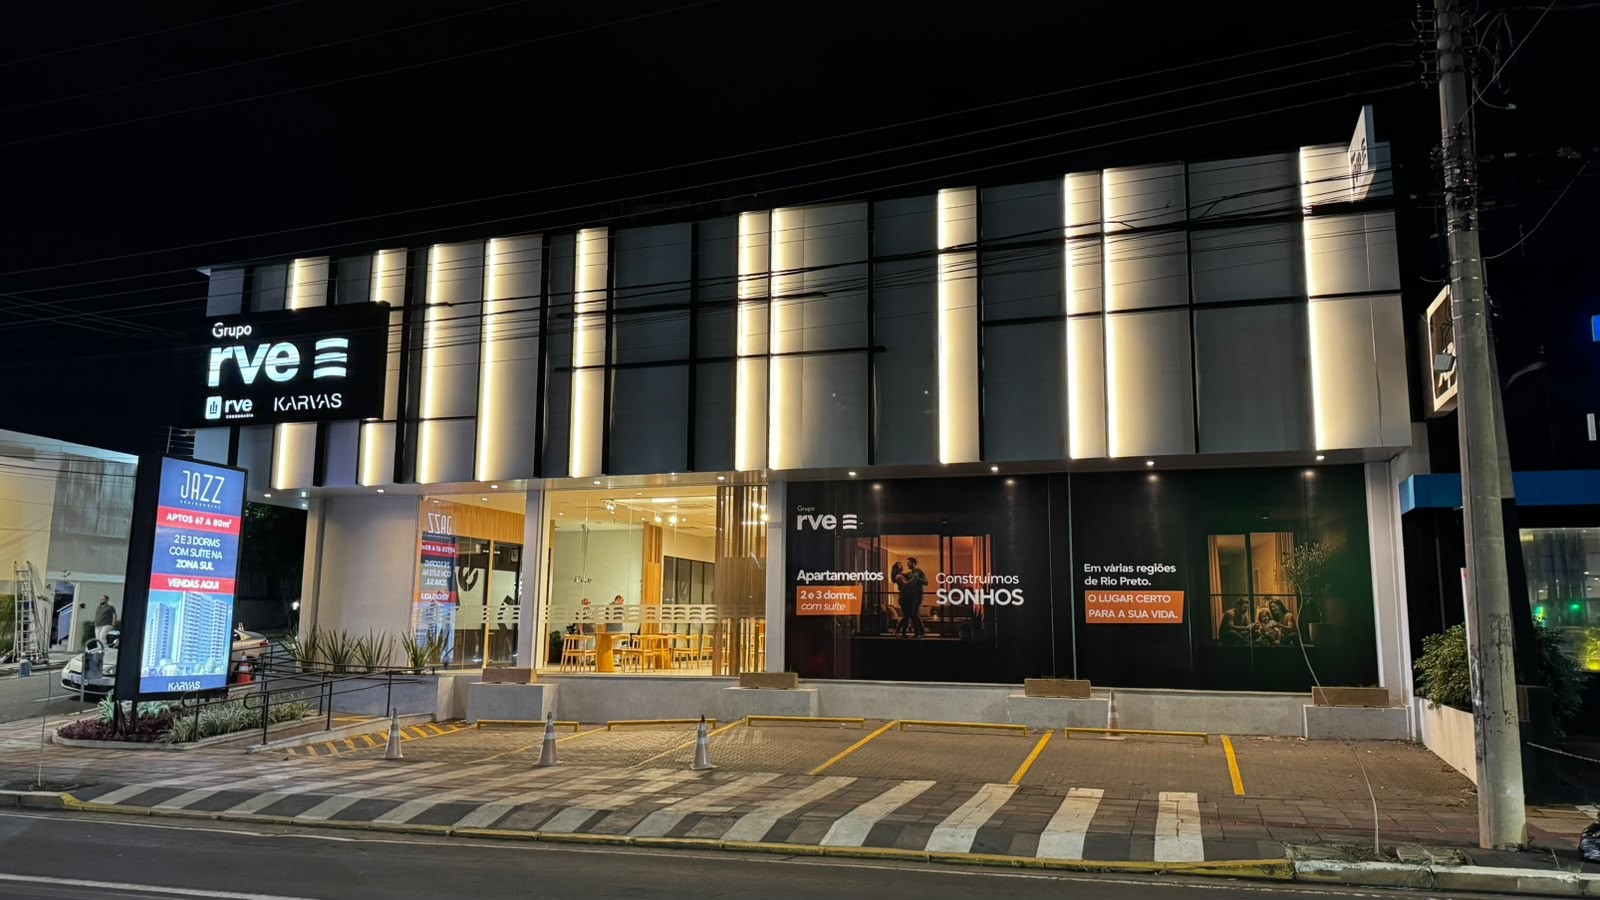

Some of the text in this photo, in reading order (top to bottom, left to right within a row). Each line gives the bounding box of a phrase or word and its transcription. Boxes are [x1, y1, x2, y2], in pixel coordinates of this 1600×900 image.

[212, 322, 252, 339] Grupo
[208, 341, 300, 387] rve
[225, 398, 253, 413] rve
[273, 393, 342, 412] KARVAS
[180, 470, 225, 504] JAZZ
[797, 505, 815, 513] Grupo
[166, 513, 194, 524] APTOS
[195, 516, 205, 525] 67
[205, 518, 211, 526] A
[796, 514, 837, 531] rve
[174, 534, 221, 548] 2 E 3 DORMS
[169, 546, 189, 557] COM
[212, 551, 223, 560] NA
[176, 559, 214, 571] ZONA SUL
[1084, 563, 1176, 575] Em várias regiões
[797, 569, 884, 584] Apartamentos
[1084, 576, 1152, 586] de Rio Preto.
[168, 578, 220, 590] VENDAS AQUI
[800, 591, 807, 600] 2
[816, 591, 822, 600] 3
[824, 590, 856, 600] dorms.
[936, 588, 1025, 606] SONHOS
[1088, 594, 1172, 604] O LUGAR CERTO
[801, 602, 822, 611] com
[1089, 609, 1178, 619] PARA A SUA VIDA.
[168, 681, 201, 691] KARVAS
